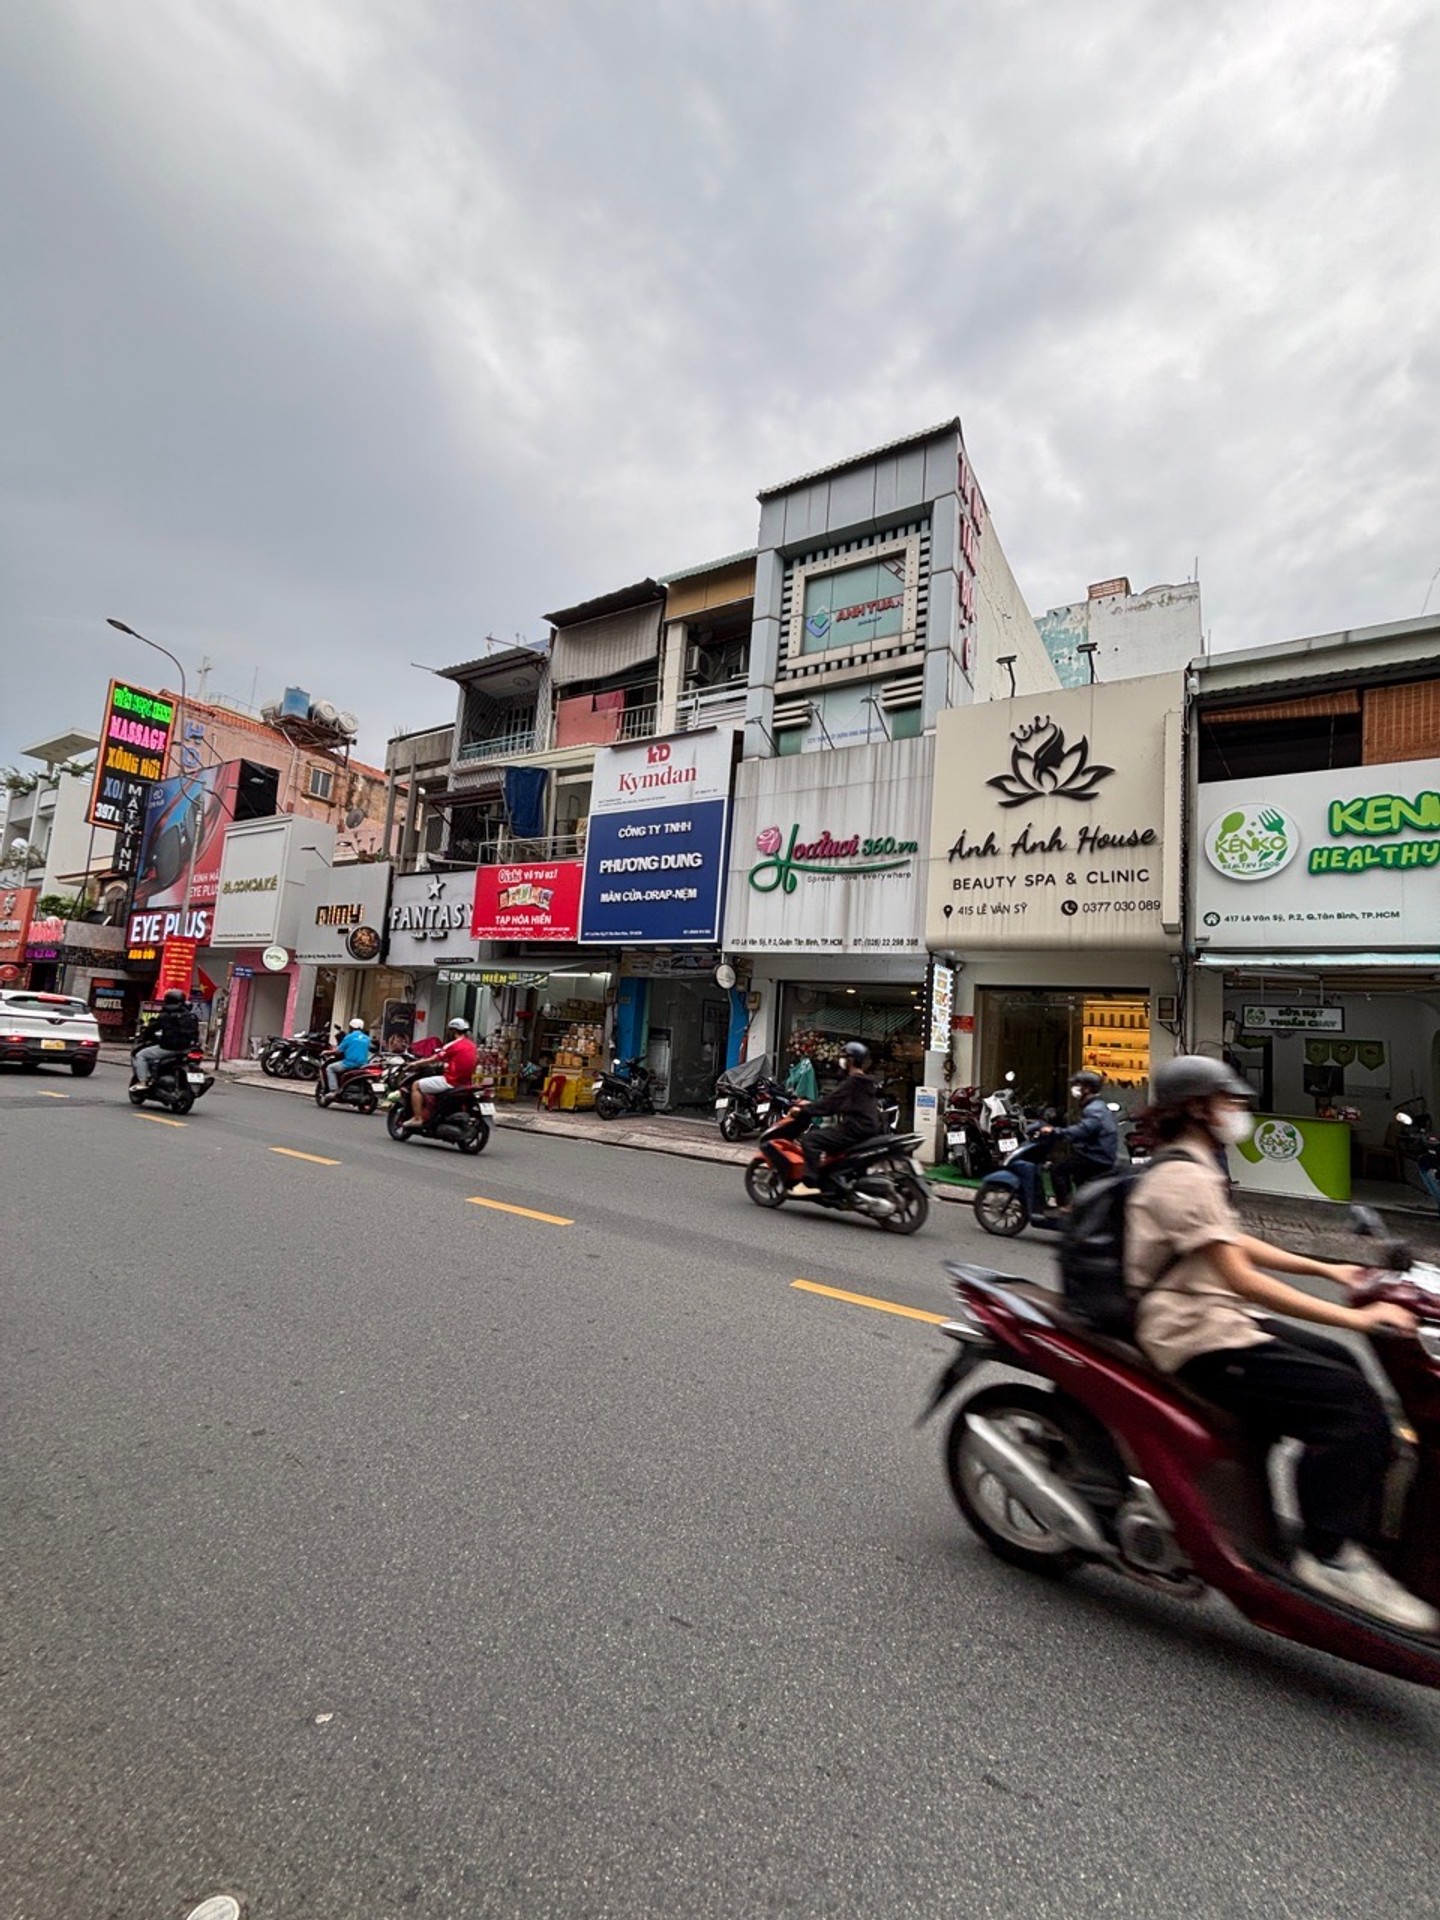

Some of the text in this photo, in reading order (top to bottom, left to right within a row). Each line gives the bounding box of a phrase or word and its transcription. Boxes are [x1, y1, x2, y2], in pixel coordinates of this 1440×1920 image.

[109, 715, 167, 751] MASSAGE
[618, 765, 697, 794] Kymdan
[618, 821, 691, 838] CÔNG TY TNHH
[1077, 825, 1157, 854] House
[600, 852, 703, 874] PHƯƠNG DUNG
[1309, 841, 1440, 874] HEALTHY
[953, 869, 1150, 890] BEAUTY SPA & CLINIC
[390, 903, 474, 931] FANTASY
[958, 905, 974, 915] 415
[1082, 900, 1161, 913] 0377 030 089
[1224, 914, 1239, 922] 417
[1361, 911, 1400, 919] TP.HCM
[130, 910, 207, 942] EYE PLUS
